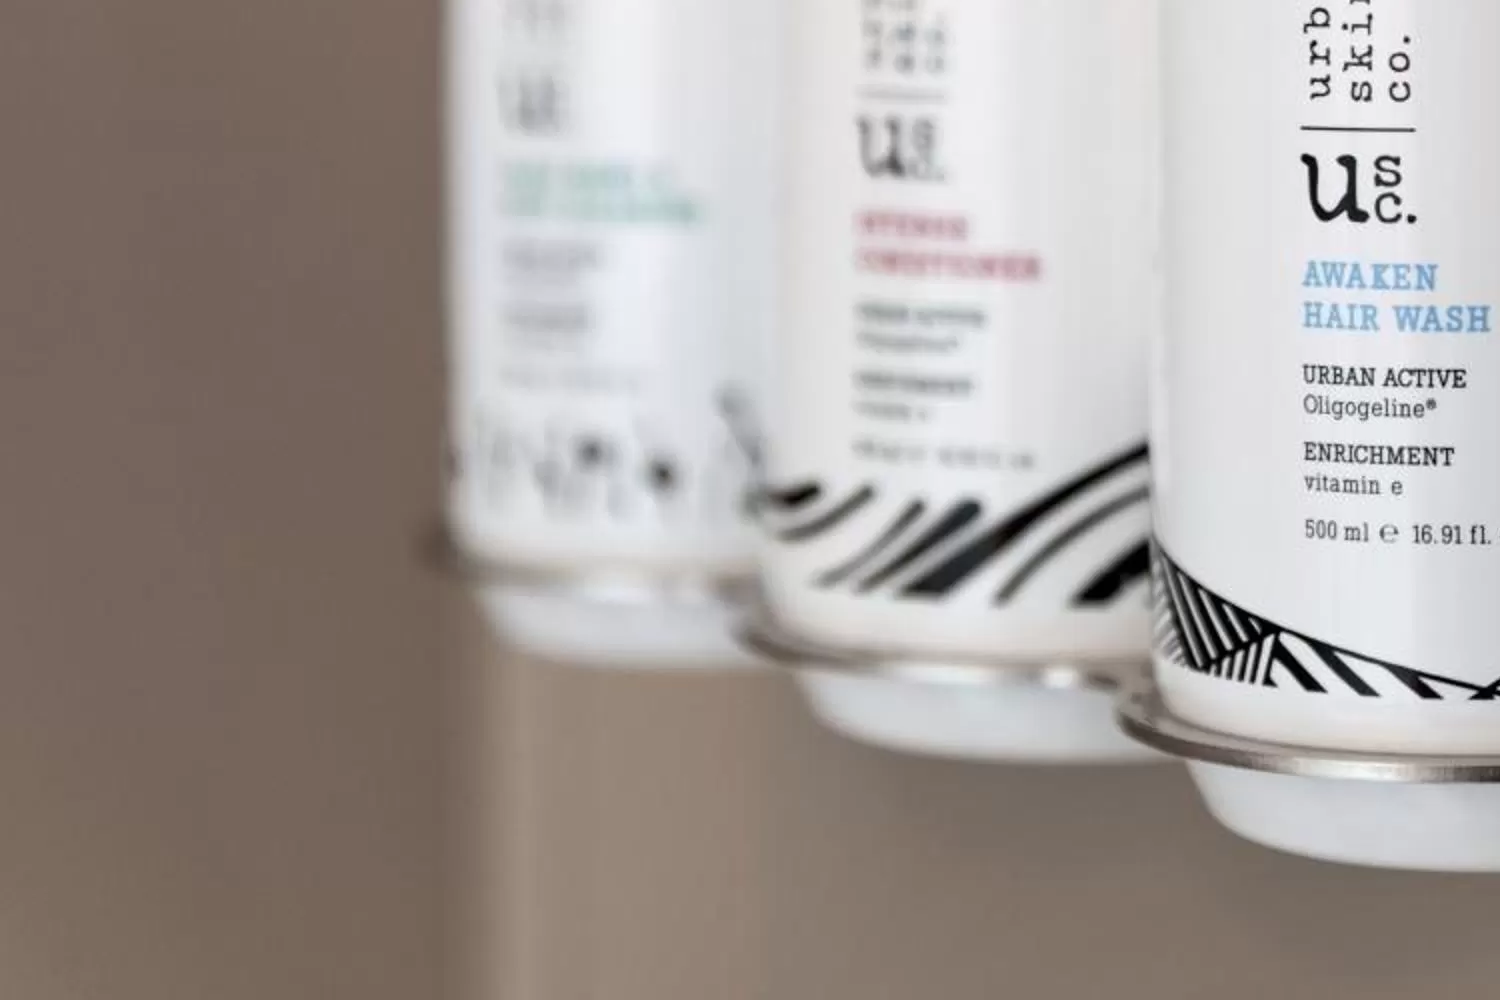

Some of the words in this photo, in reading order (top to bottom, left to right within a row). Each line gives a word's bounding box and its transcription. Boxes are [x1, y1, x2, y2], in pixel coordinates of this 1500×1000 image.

[1387, 35, 1412, 104] co.
[1301, 260, 1439, 292] AWAKEN
[1303, 301, 1380, 332] HAIR
[1393, 304, 1491, 333] WASH
[1302, 364, 1376, 388] URBAN
[1382, 367, 1468, 390] ACTIVE
[1302, 440, 1456, 468] ENRICHMENT
[1303, 473, 1381, 496] vitamin
[1390, 480, 1403, 497] e
[1304, 517, 1338, 541] 500
[1343, 521, 1370, 543] ml
[1411, 523, 1464, 546] 16.91
[1469, 523, 1493, 546] fl.
